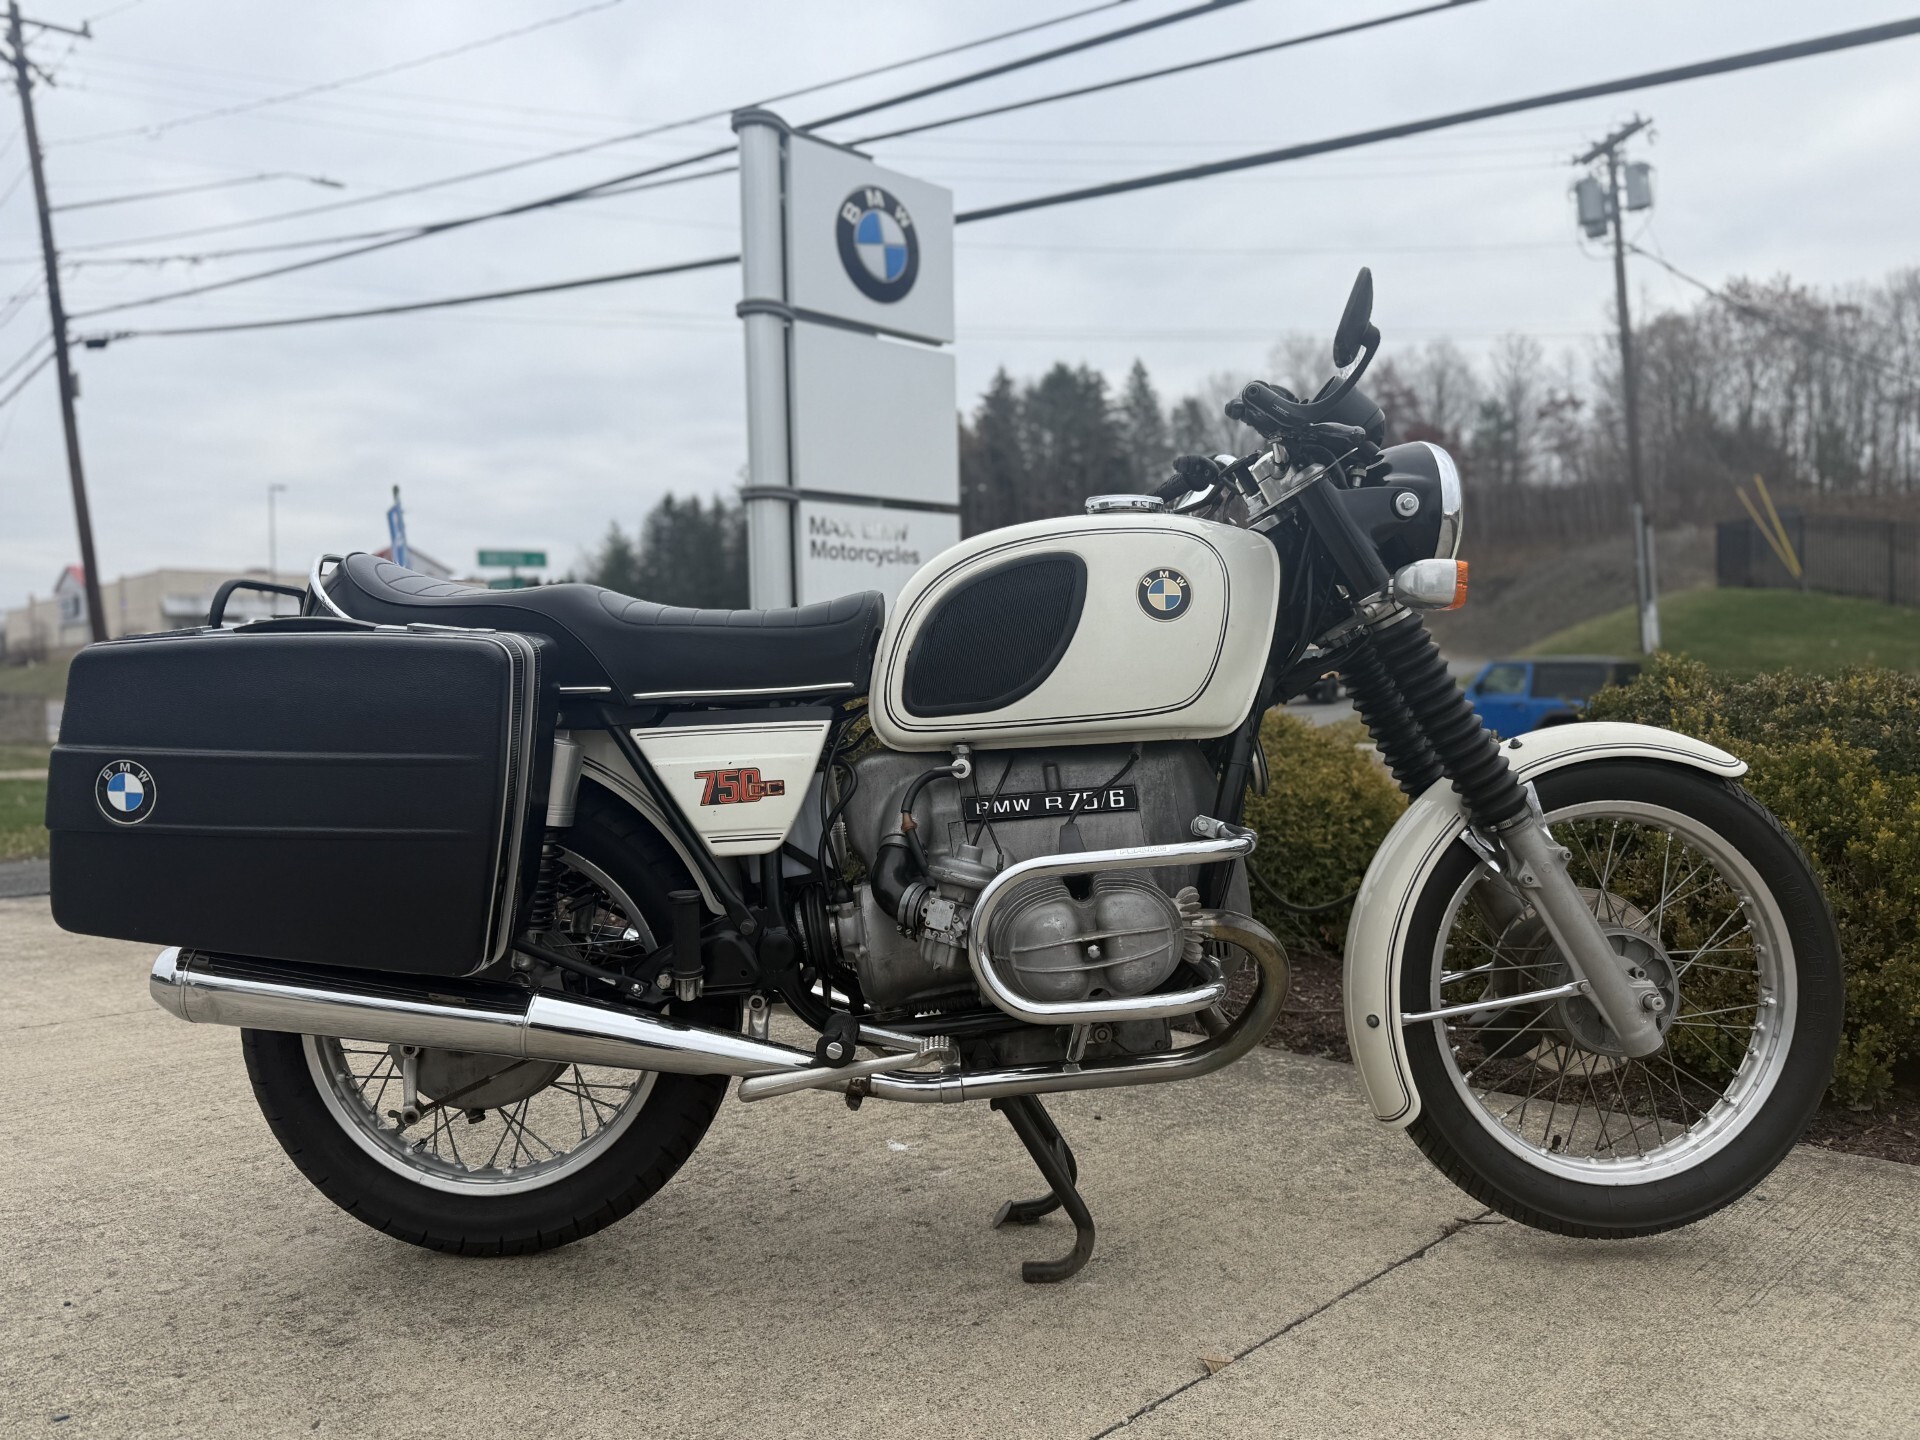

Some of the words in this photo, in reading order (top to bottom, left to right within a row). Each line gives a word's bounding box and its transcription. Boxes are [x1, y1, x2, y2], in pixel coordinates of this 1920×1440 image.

[841, 188, 911, 228] BMW
[810, 540, 920, 567] Motorcycles
[1142, 570, 1187, 587] BMW
[102, 762, 150, 783] BMW
